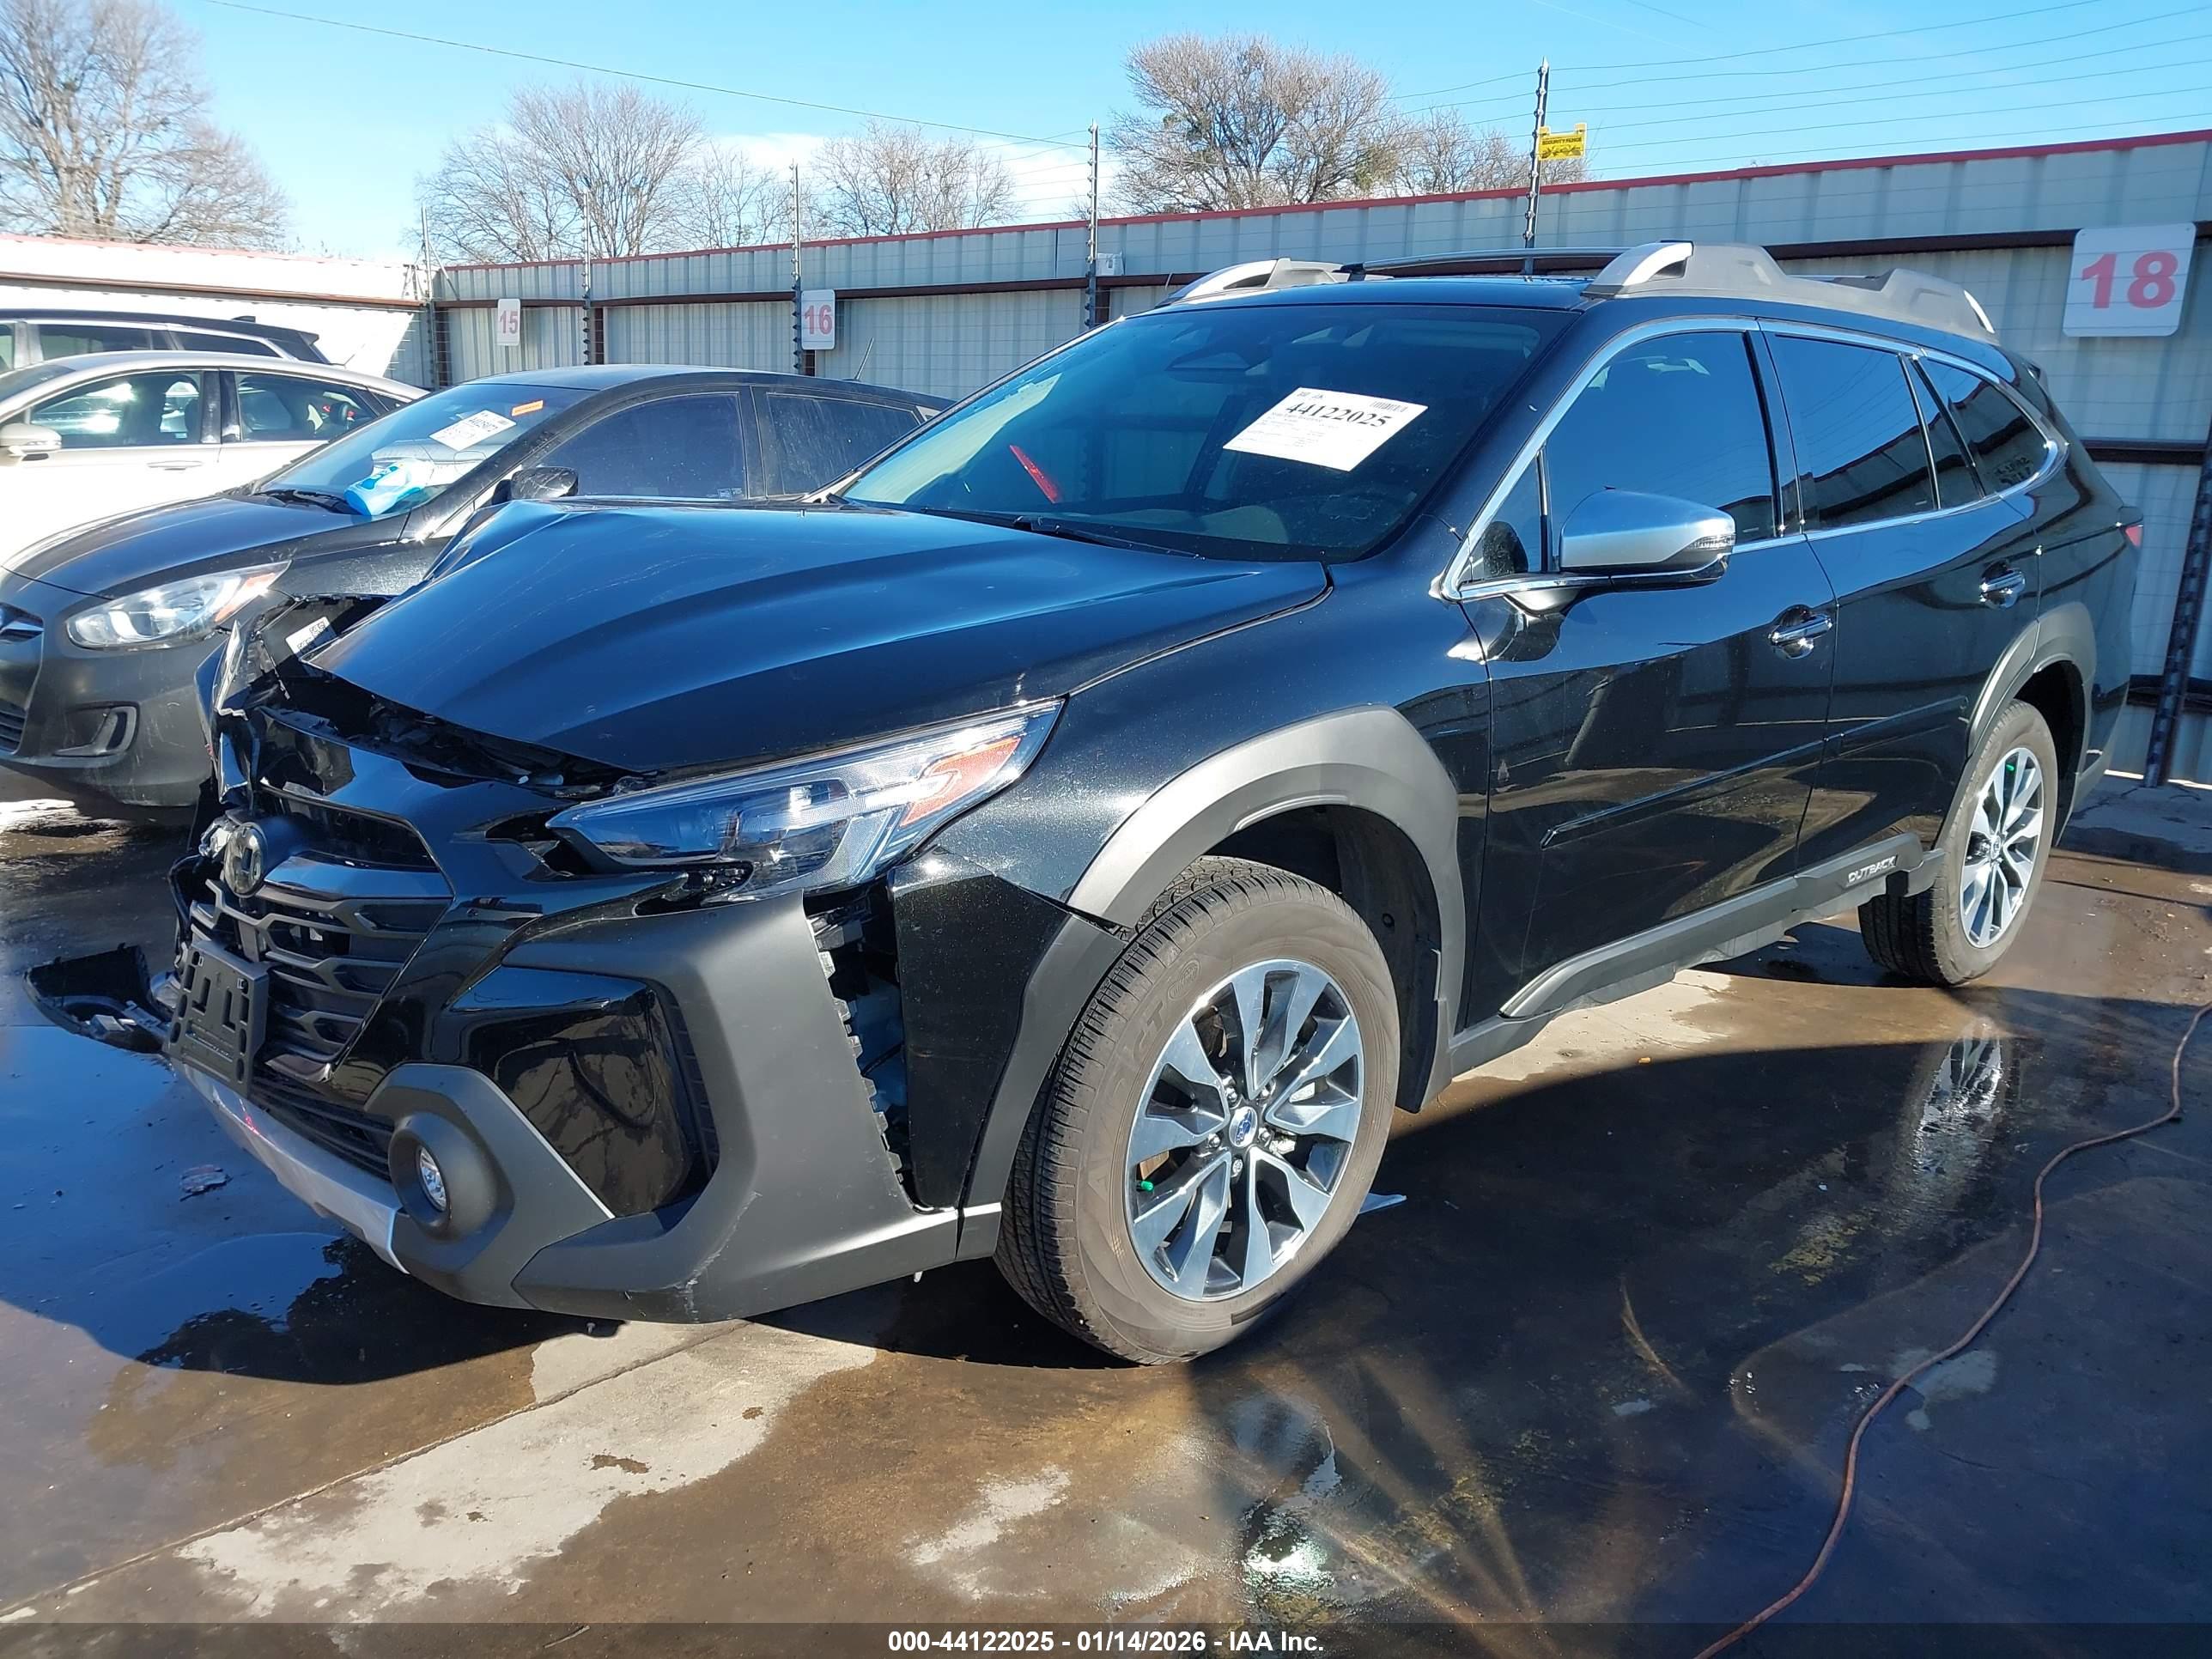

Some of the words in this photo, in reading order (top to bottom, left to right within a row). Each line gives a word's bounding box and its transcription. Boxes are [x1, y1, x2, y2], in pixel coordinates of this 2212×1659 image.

[2081, 252, 2179, 308] 18
[500, 310, 519, 334] 15
[805, 304, 833, 335] 16
[1286, 402, 1392, 428] 44122025
[1848, 855, 1896, 883] OUTBACK
